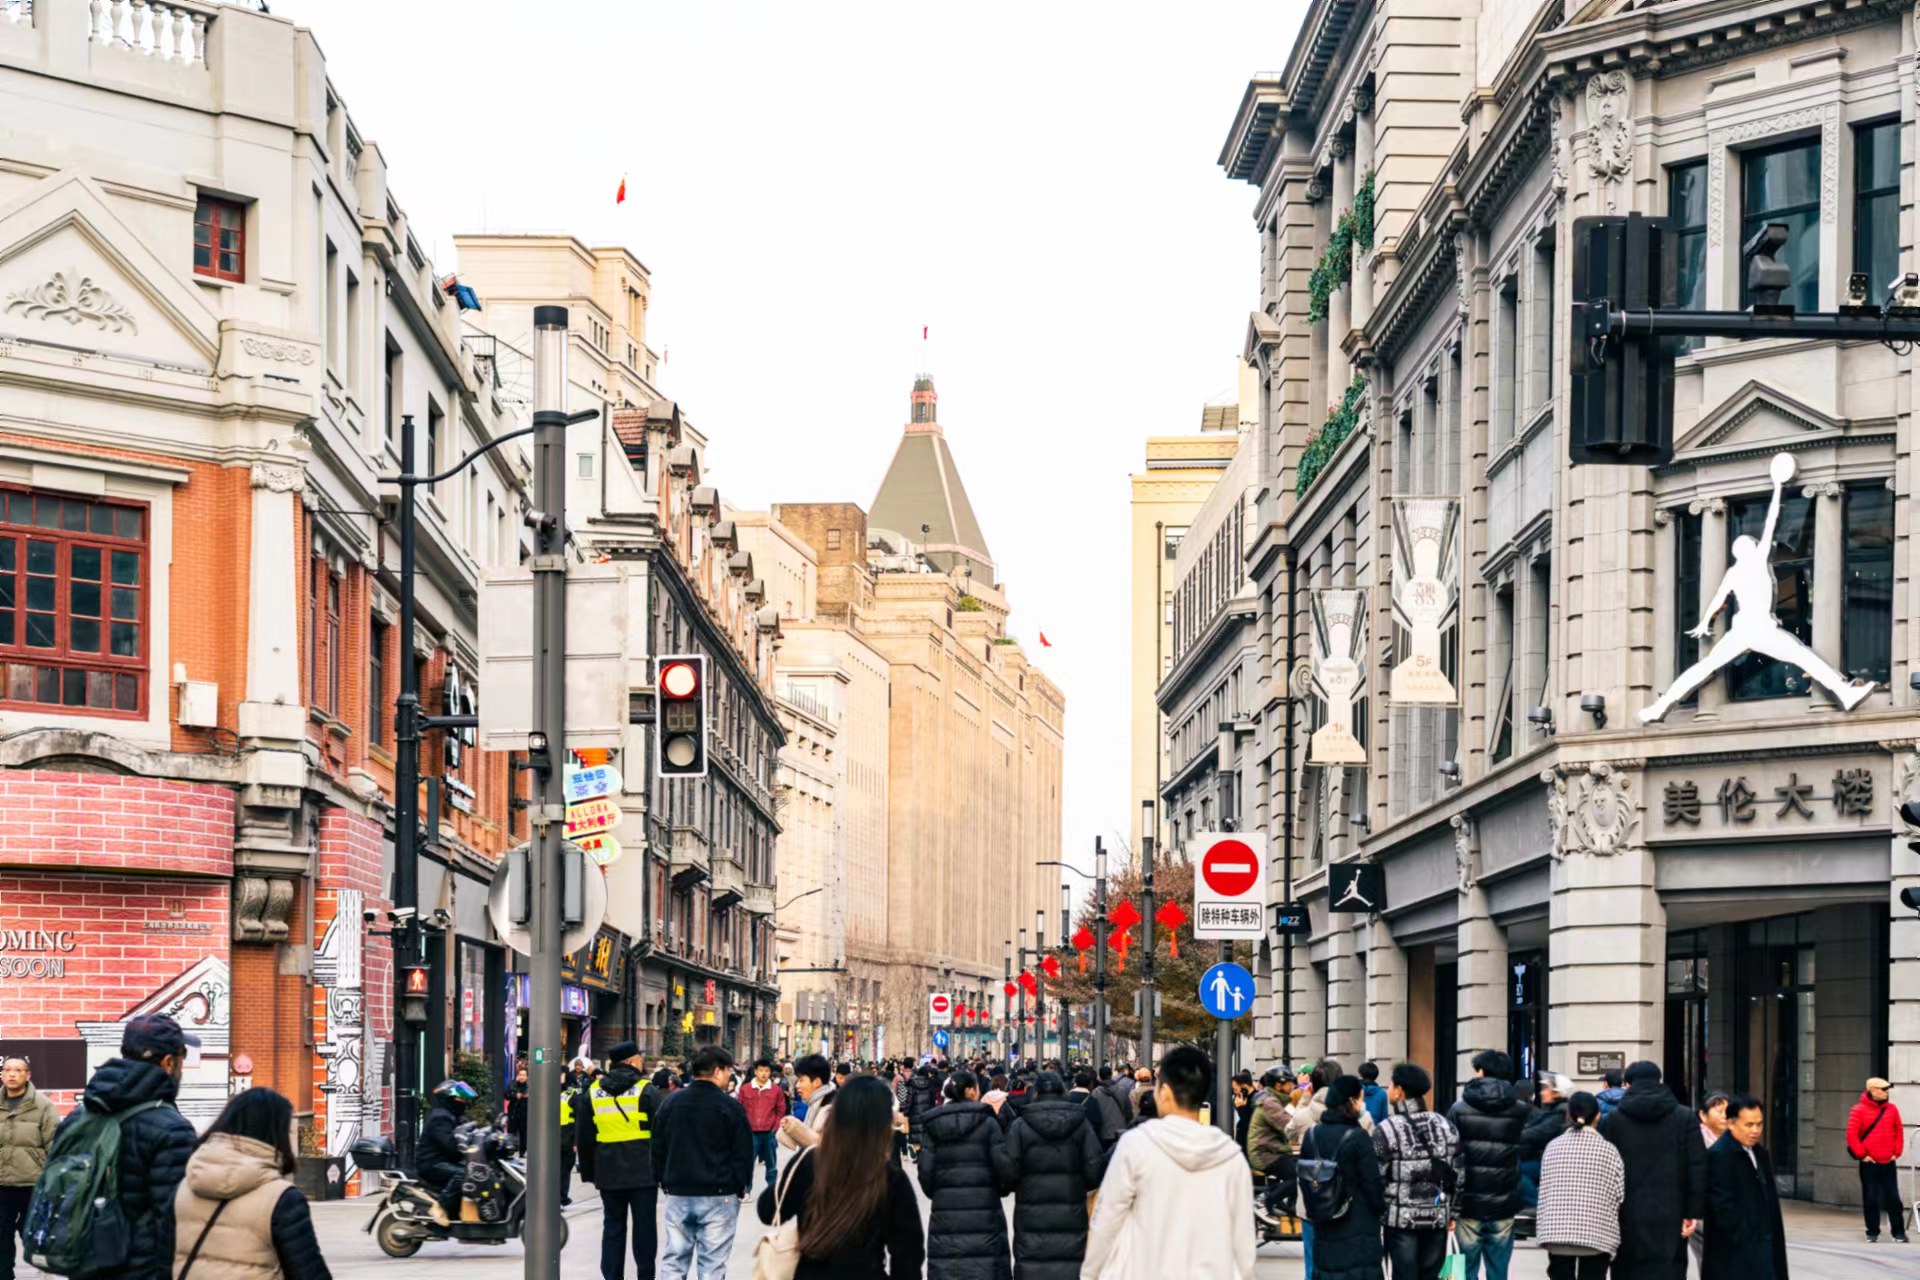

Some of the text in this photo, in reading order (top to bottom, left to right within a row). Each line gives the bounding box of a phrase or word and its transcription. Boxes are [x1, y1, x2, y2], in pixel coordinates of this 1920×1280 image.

[1663, 768, 1873, 826] 美伦大楼
[570, 803, 609, 818] ALLORA
[1201, 907, 1259, 926] 除特种车辆外
[0, 957, 65, 979] SOON
